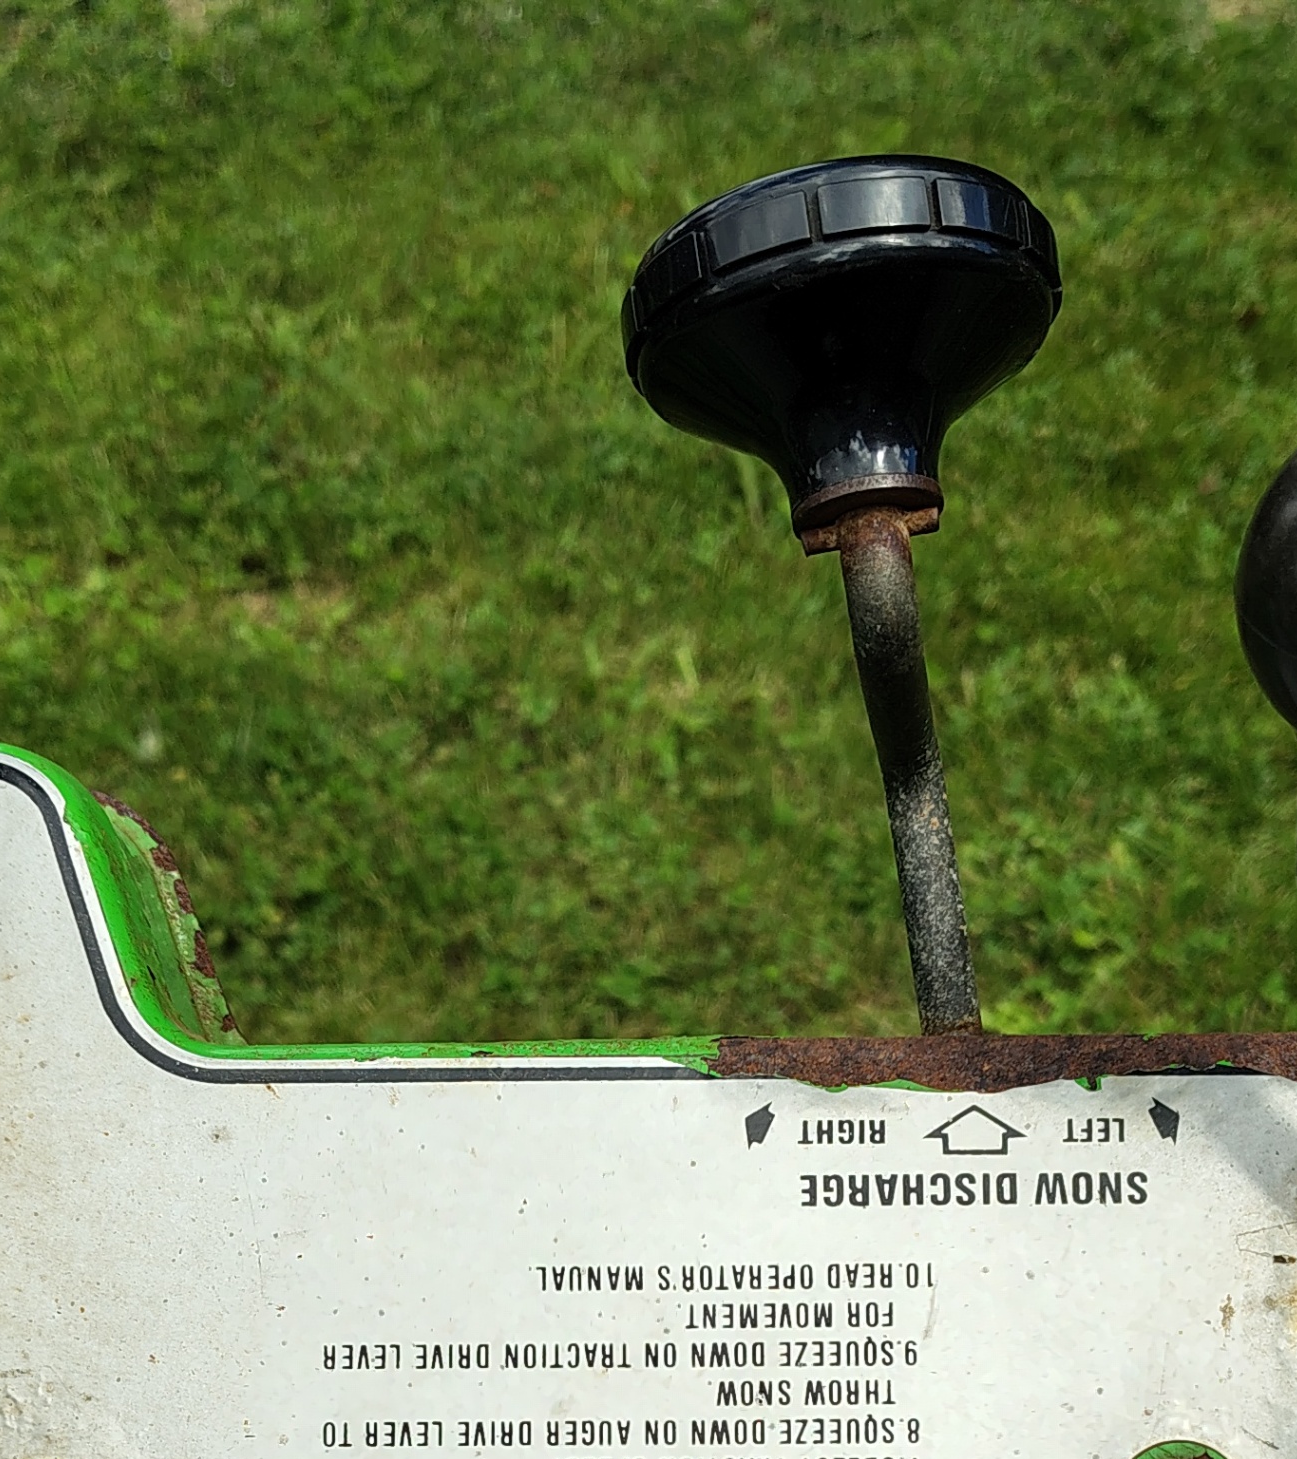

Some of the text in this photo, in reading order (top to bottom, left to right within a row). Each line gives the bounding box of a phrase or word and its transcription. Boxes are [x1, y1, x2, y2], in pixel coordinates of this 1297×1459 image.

[797, 1119, 886, 1145] RIGHT
[1062, 1117, 1125, 1143] LEFT
[799, 1171, 1148, 1209] SNOW DISCHARGE
[657, 1264, 814, 1293] OPERATOR'S
[847, 1301, 894, 1328] FOR
[323, 1344, 401, 1370] LEVER
[415, 1343, 489, 1370] DRIVE
[504, 1342, 632, 1369] TRACTION
[645, 1342, 677, 1368] ON
[691, 1341, 765, 1368] DOWN
[804, 1379, 896, 1406] THROW
[323, 1421, 353, 1448] TO
[365, 1421, 443, 1448] LEVER
[458, 1420, 532, 1447] DRIVE
[546, 1420, 631, 1447] AUGER
[645, 1420, 677, 1446] ON
[691, 1419, 765, 1446] DOWN
